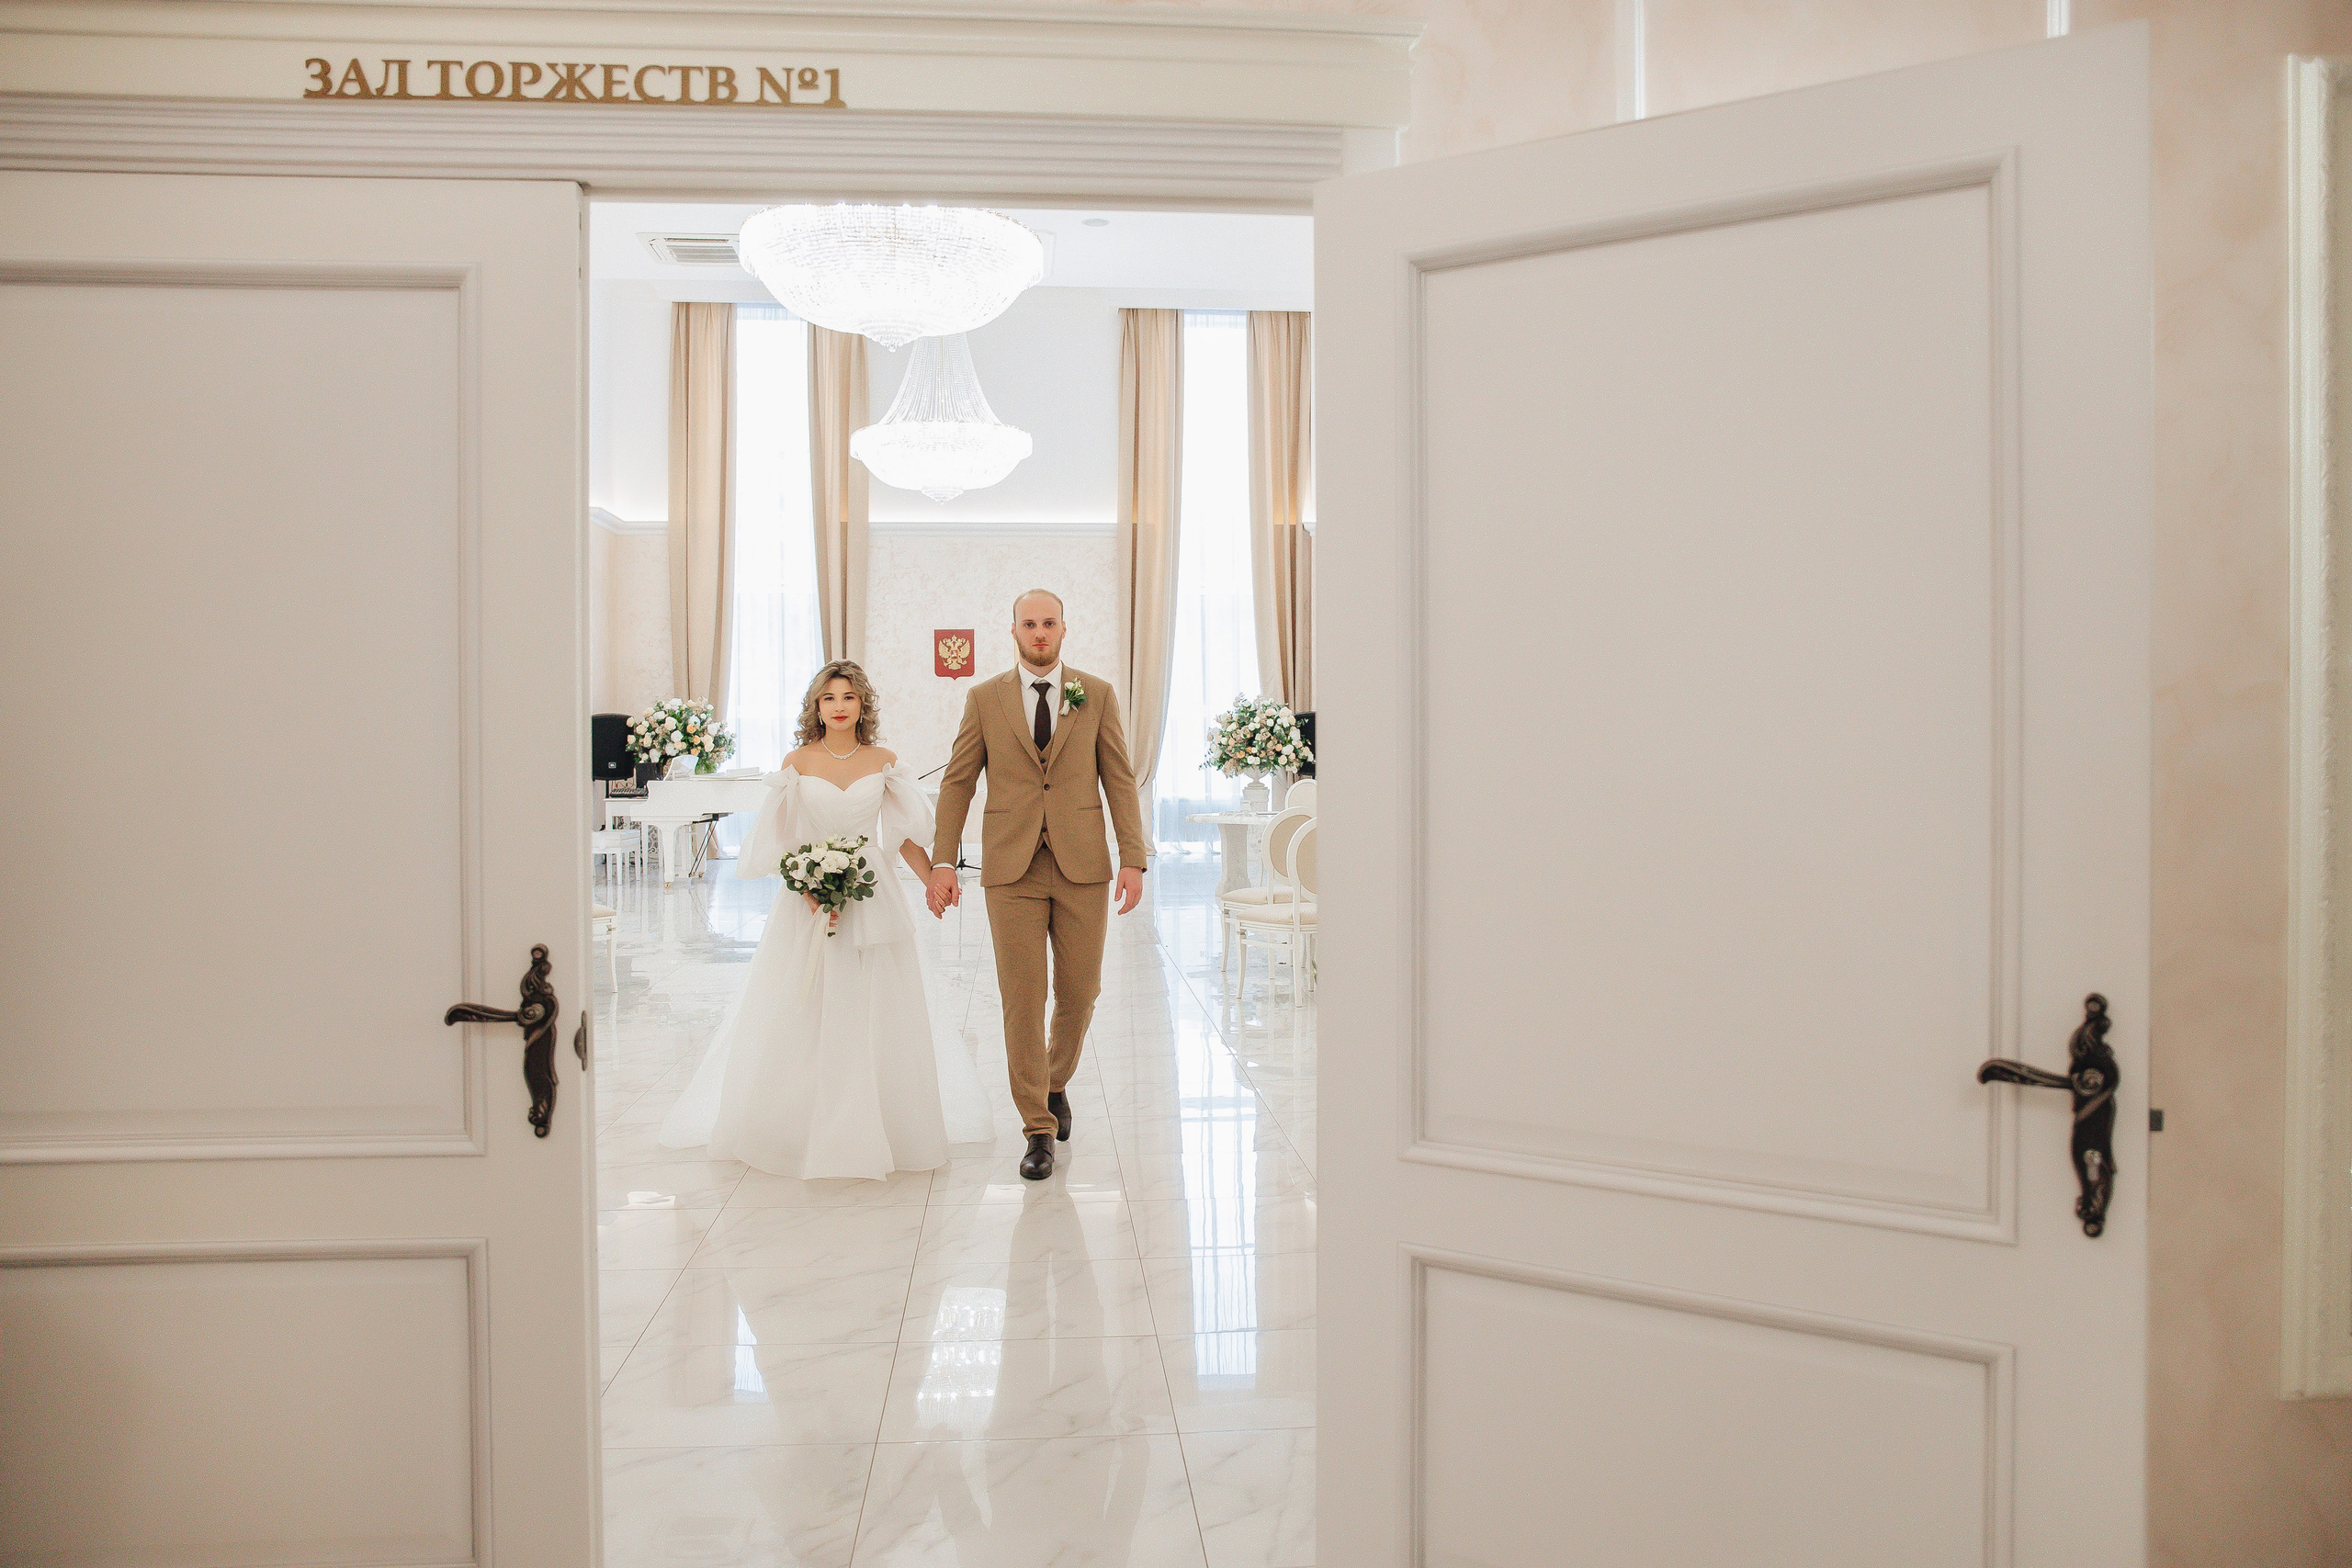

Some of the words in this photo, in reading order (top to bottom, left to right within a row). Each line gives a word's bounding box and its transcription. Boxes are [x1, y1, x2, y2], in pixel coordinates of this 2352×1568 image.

[302, 57, 412, 99] ЗАЛ
[426, 59, 739, 107] ТОРЖЕСТВ
[755, 67, 847, 108] №1
